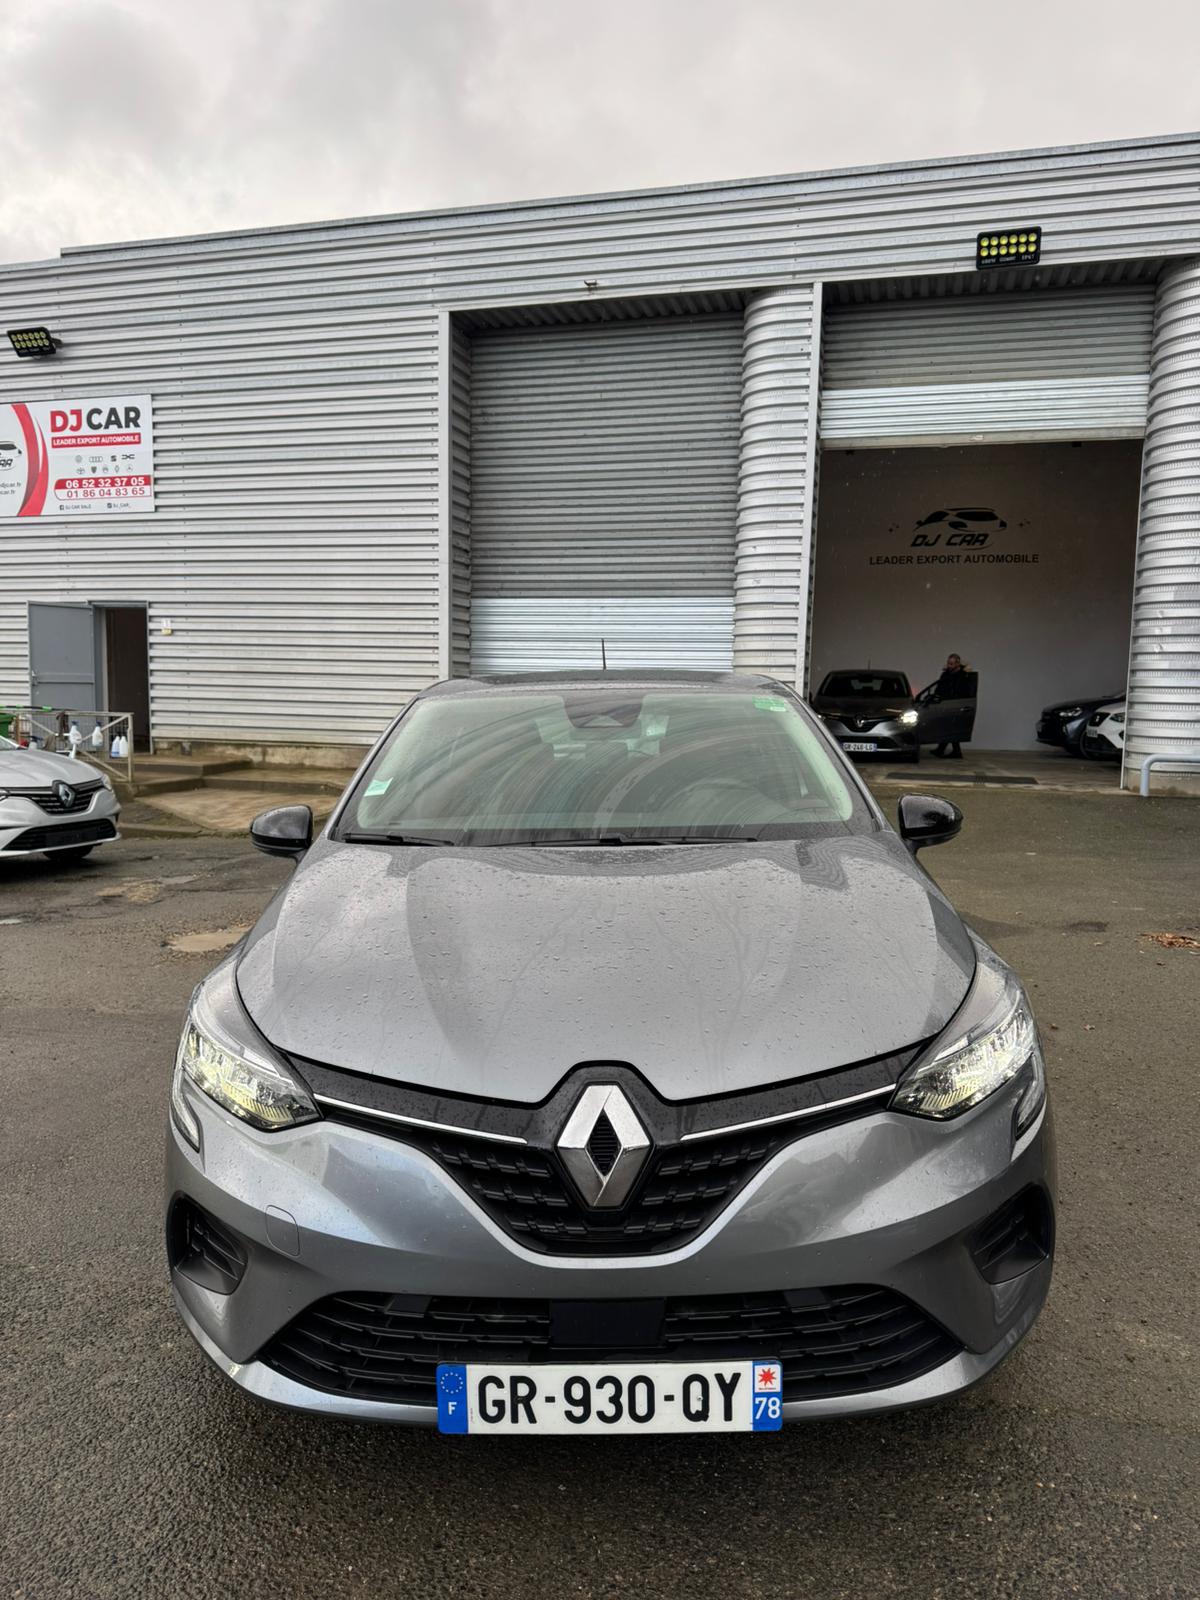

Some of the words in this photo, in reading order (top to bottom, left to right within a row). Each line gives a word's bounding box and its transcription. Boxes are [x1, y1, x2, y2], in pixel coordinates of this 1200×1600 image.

[50, 409, 82, 432] DJ
[86, 406, 141, 430] CAR
[52, 438, 77, 446] LEADER
[101, 435, 140, 443] AUTOMOBILE
[0, 458, 13, 467] AR
[66, 480, 79, 488] 06
[82, 479, 95, 488] 52
[98, 478, 111, 487] 32
[114, 477, 128, 486] 37
[130, 477, 145, 486] 05
[67, 490, 79, 498] 01
[82, 489, 96, 497] 86
[98, 488, 112, 497] 04
[115, 488, 128, 496] 83
[131, 487, 145, 495] 65
[911, 534, 942, 547] DJ
[945, 533, 989, 546] CAR
[869, 555, 914, 565] LEADER
[916, 555, 961, 564] EXPORT
[964, 553, 1040, 563] AUTOMOBILE
[477, 1372, 742, 1424] GR-930-QY
[448, 1401, 457, 1415] F
[754, 1397, 781, 1420] 78
